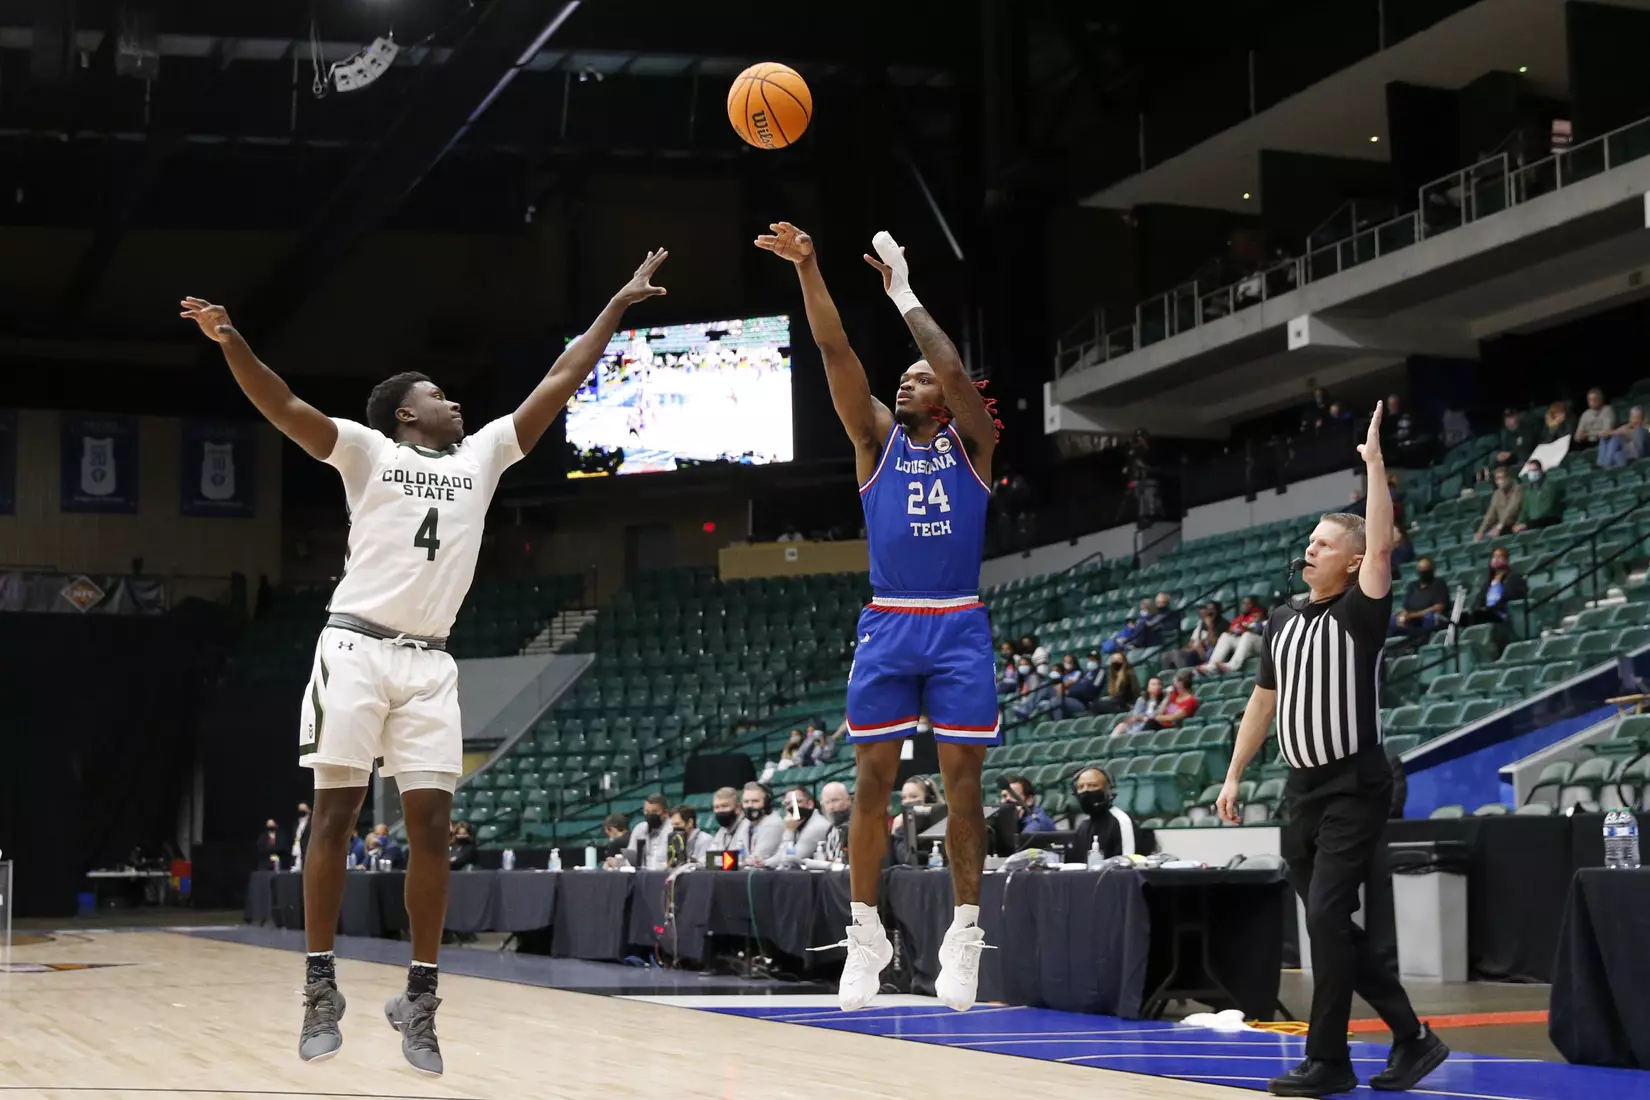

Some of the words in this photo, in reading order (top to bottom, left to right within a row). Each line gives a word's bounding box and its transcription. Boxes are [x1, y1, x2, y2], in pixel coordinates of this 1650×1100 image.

[752, 109, 776, 149] Wilso
[895, 453, 957, 475] LOUSIANA
[382, 469, 473, 490] COLORADO
[403, 484, 455, 501] STATE
[907, 478, 951, 515] 24
[413, 506, 441, 562] 4
[910, 520, 952, 537] TECH
